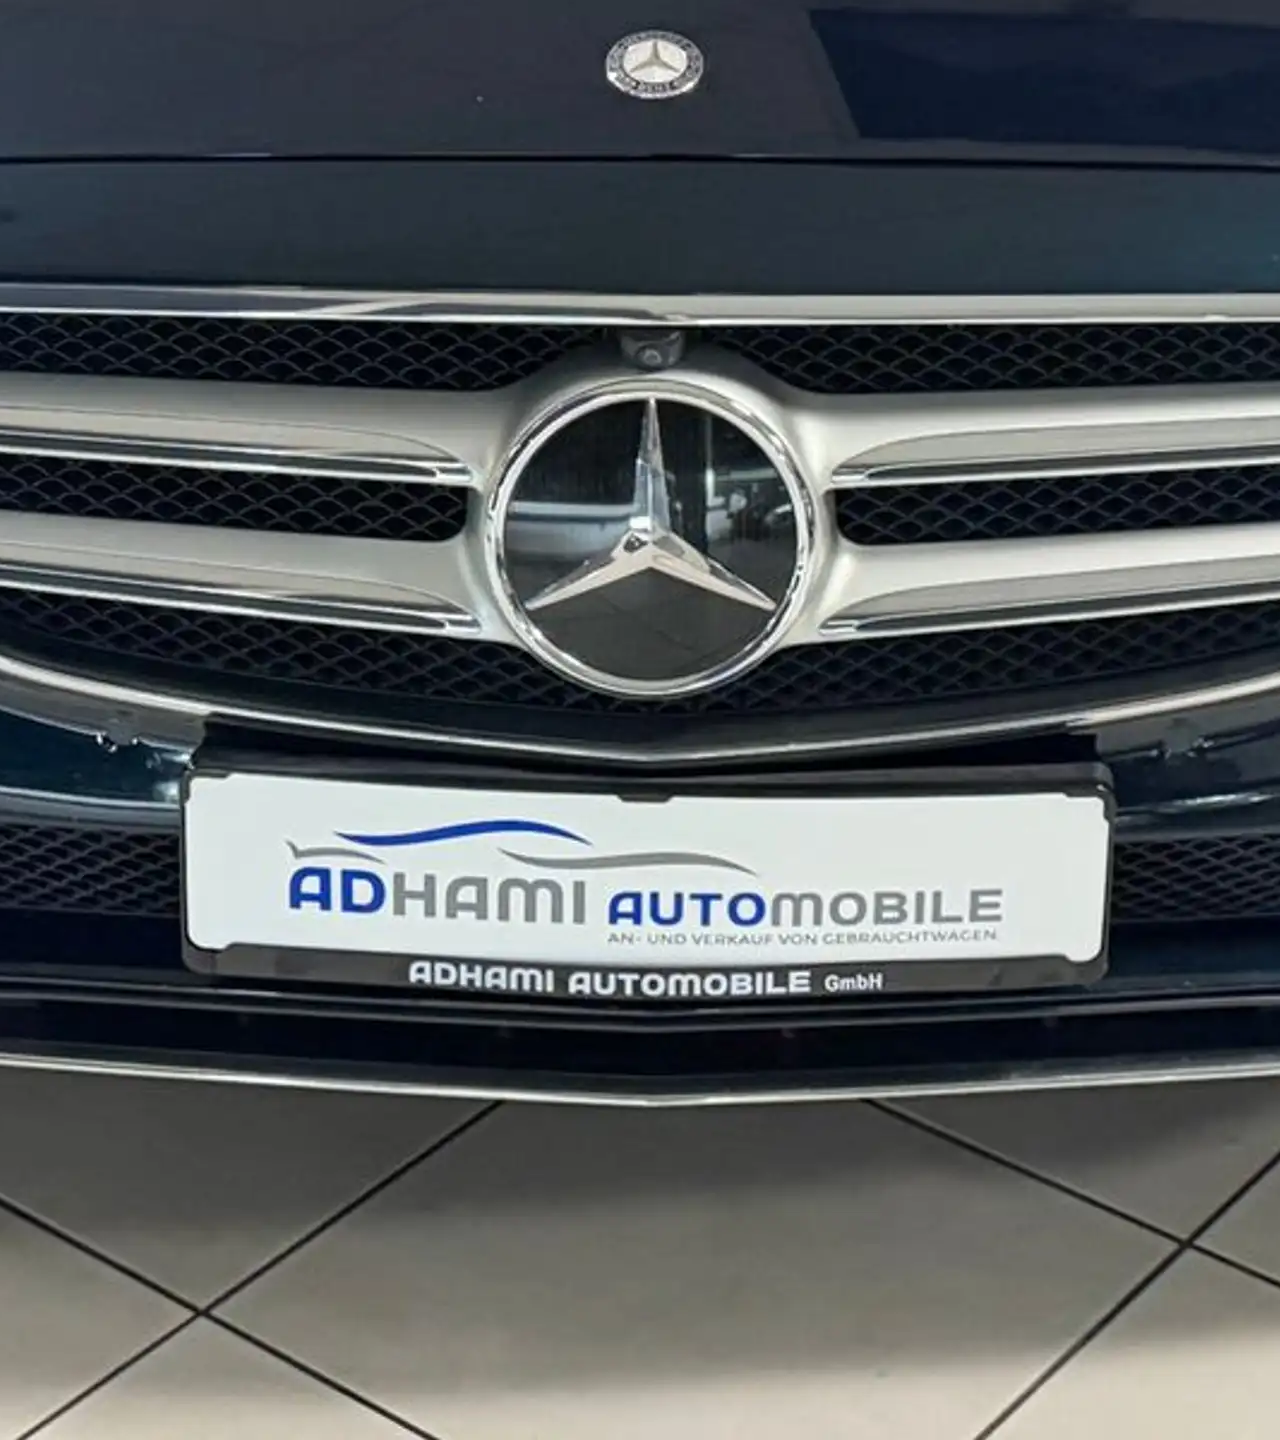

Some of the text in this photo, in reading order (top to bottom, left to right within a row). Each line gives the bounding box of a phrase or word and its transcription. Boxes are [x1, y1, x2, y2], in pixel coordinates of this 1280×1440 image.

[288, 865, 1004, 927] ADHAMI AUTOMOBILE
[646, 932, 687, 946] UND
[691, 932, 775, 947] VERKAUF
[778, 932, 818, 947] VON
[822, 928, 998, 946] GEBRAUCHTWAGEN
[408, 959, 884, 998] ADHAMI AUTOMOBILE GmbH
